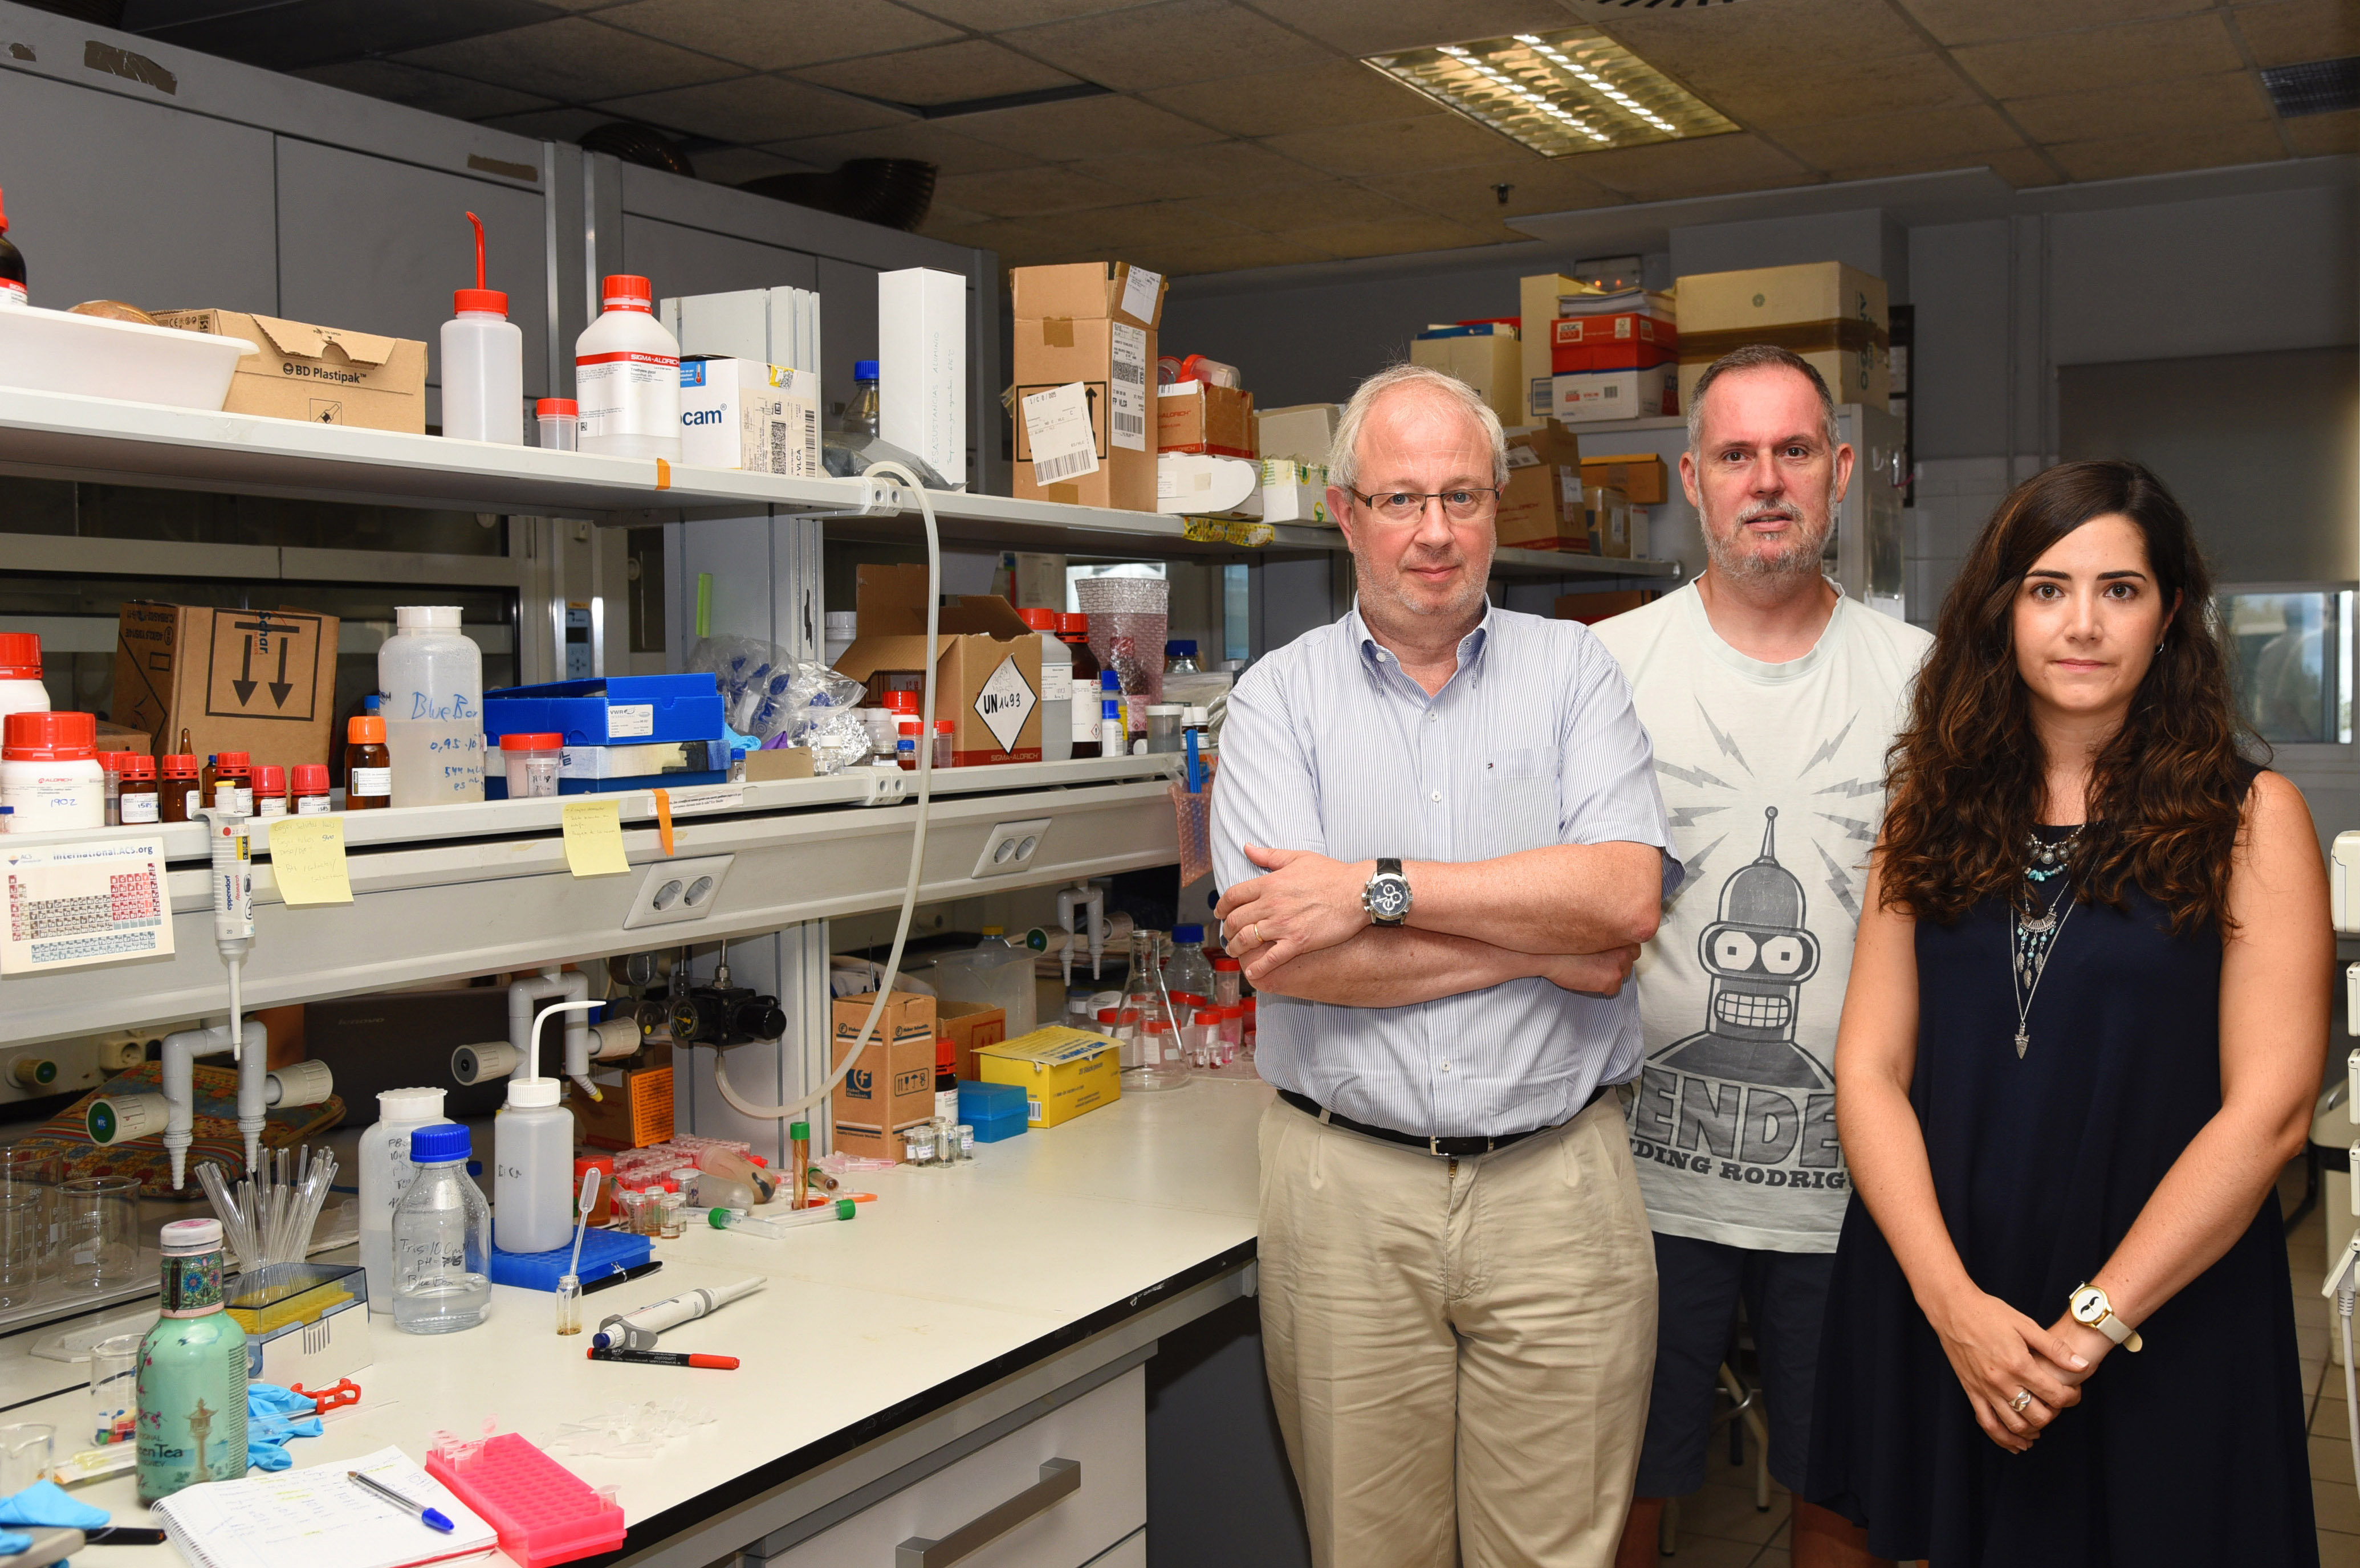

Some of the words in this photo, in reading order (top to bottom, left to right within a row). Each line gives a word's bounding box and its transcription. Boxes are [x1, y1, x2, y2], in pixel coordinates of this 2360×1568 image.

[630, 354, 679, 365] SIGMA-ALDRICH
[296, 366, 310, 376] BD
[1158, 410, 1191, 419] -ALDRICH
[259, 610, 271, 655] Schar
[983, 694, 998, 714] UN
[999, 693, 1020, 710] 1493
[991, 752, 1039, 761] SIGMA-ALDRICH
[51, 799, 78, 808] 1902
[1616, 1066, 1848, 1168] ENDE
[1719, 1161, 1854, 1190] RODRIG
[400, 1239, 424, 1254] Tris
[154, 1443, 183, 1458] Tea
